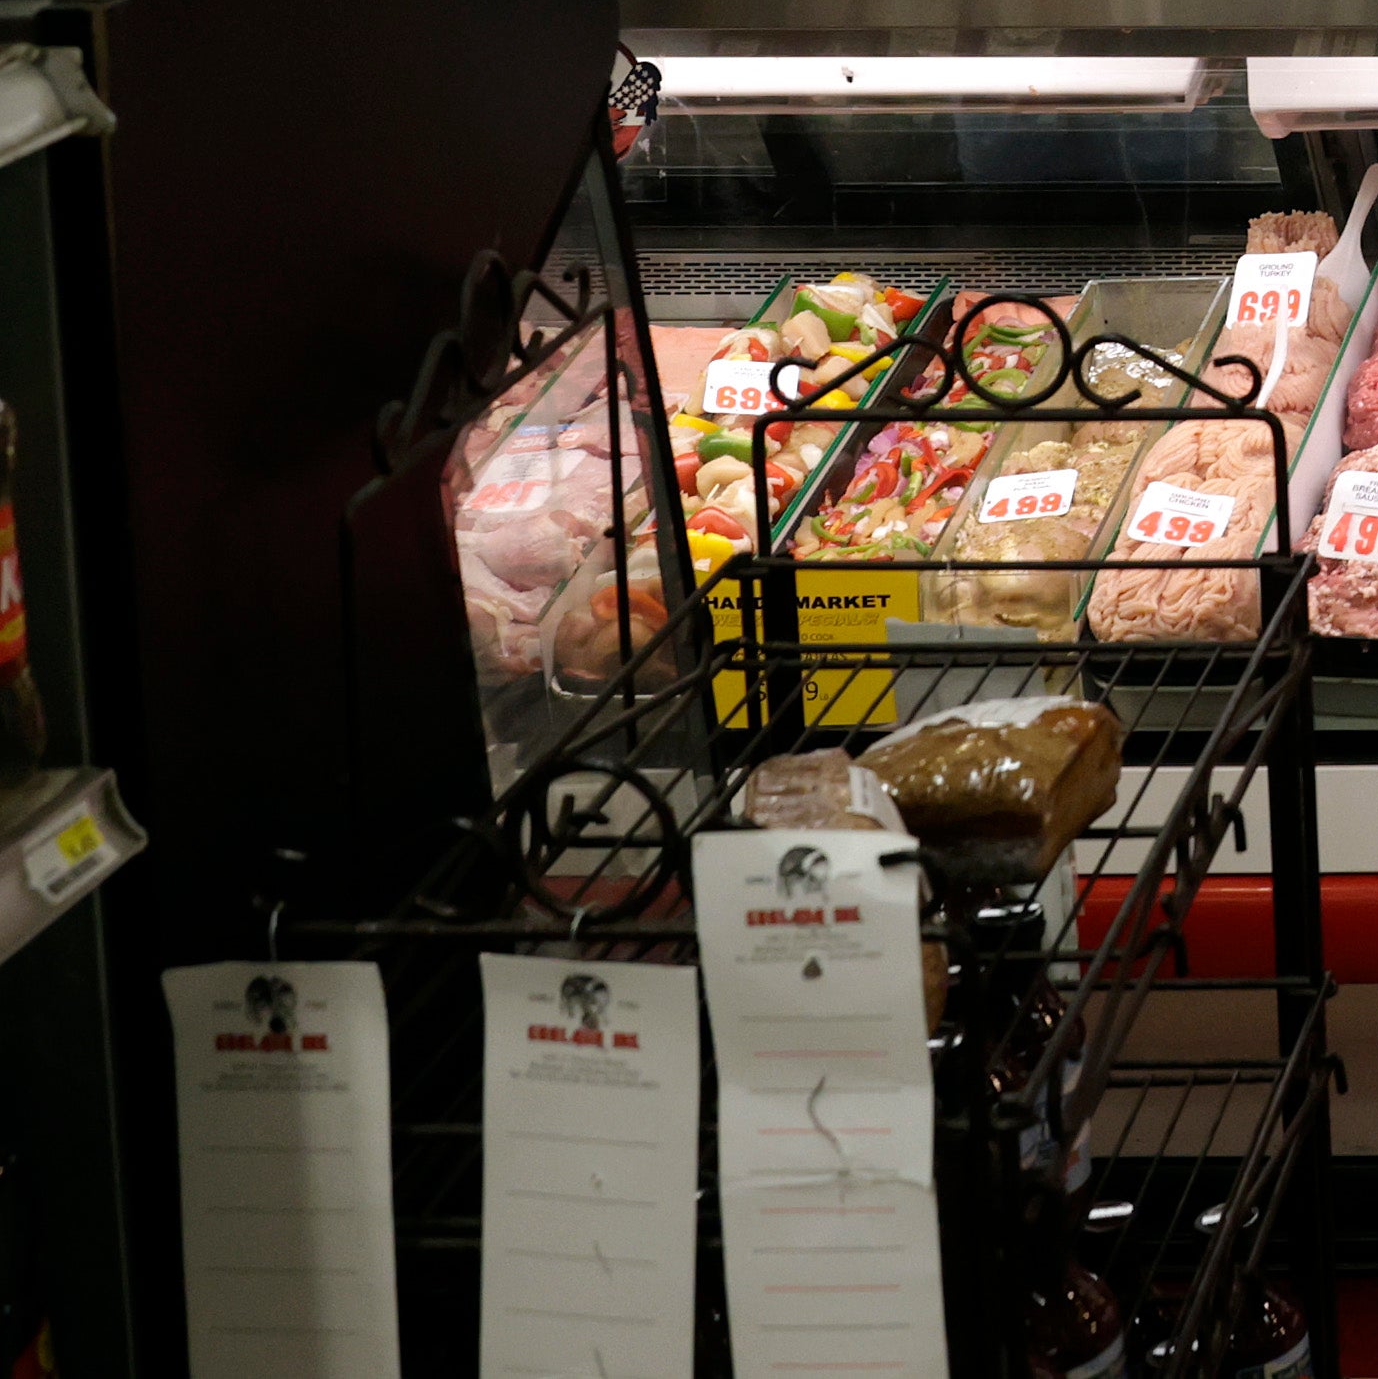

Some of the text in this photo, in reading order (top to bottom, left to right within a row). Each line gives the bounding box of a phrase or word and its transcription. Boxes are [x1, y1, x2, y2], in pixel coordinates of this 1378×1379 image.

[1258, 262, 1294, 271] GROUND
[1260, 270, 1292, 278] TURKEY
[1237, 288, 1301, 323] 699
[987, 492, 1063, 517] 499
[1168, 497, 1210, 510] CHICKEN
[1136, 510, 1215, 543] 499
[797, 594, 891, 609] MARKET
